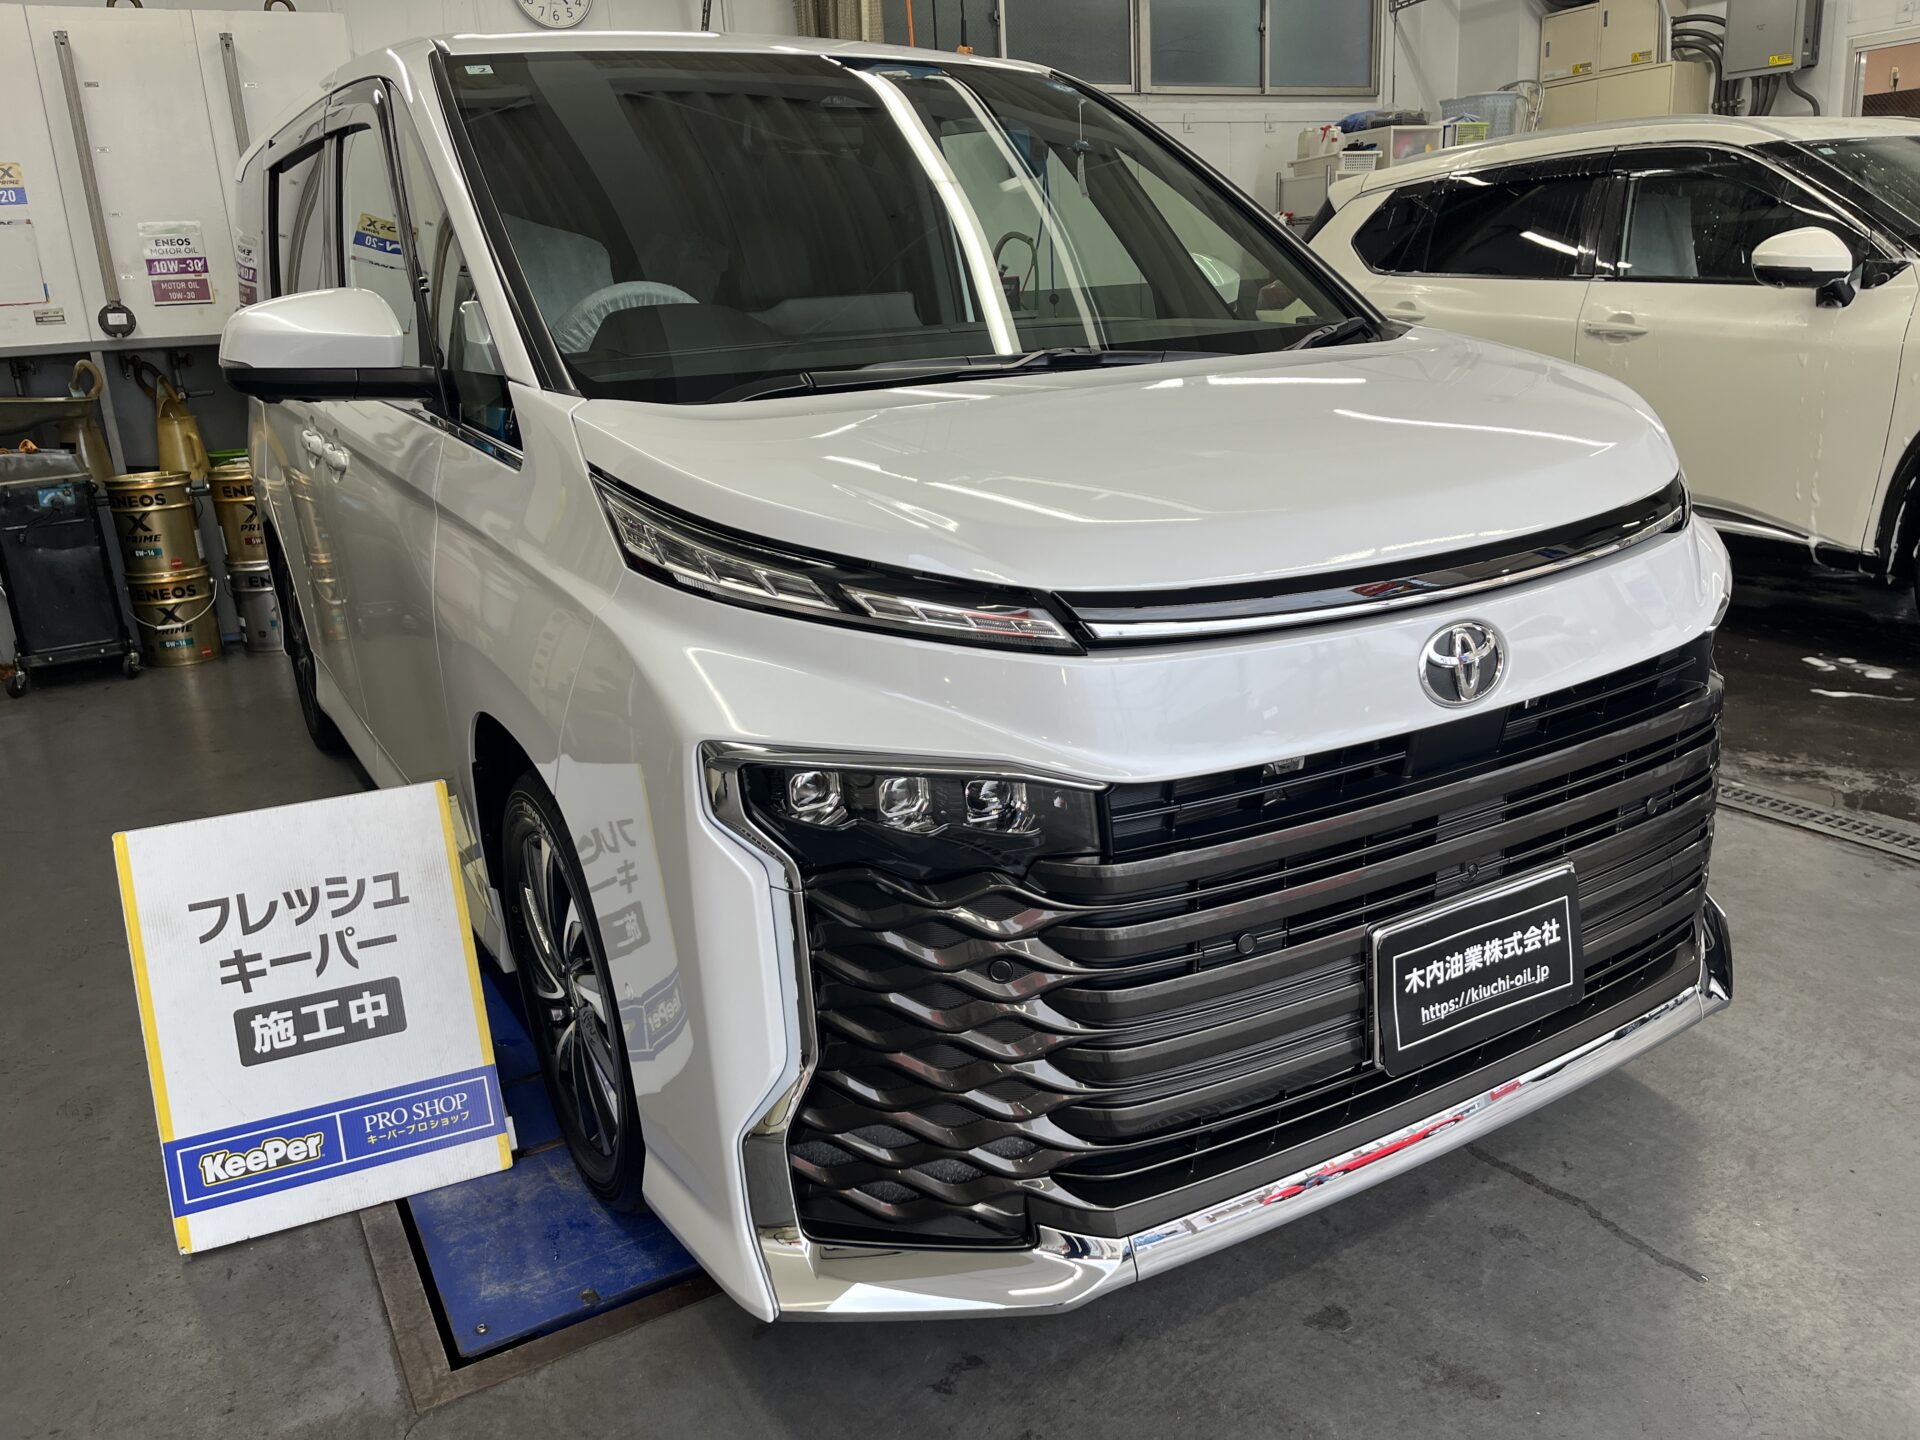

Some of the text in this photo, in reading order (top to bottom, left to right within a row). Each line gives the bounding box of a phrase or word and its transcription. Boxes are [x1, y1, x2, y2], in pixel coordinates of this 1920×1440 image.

[538, 5, 545, 17] 7
[552, 10, 560, 21] 6
[566, 7, 573, 18] 5
[154, 238, 191, 247] ENEOS
[153, 259, 201, 273] 10W-30
[161, 281, 187, 289] MOTOR
[168, 292, 196, 300] 10W-30
[125, 534, 162, 544] PRIME
[137, 584, 197, 600] ENEOS
[187, 871, 410, 945] フレッシュ
[219, 926, 398, 994] キーパー
[1404, 917, 1562, 994] 木内油業株式会社
[1421, 964, 1550, 1024] https://kiuchi-oil.jp
[250, 990, 390, 1054] 施工中
[363, 1092, 468, 1133] PRO SHOP
[366, 1110, 470, 1145] キーパープロショップ
[200, 1133, 323, 1185] KeePer
